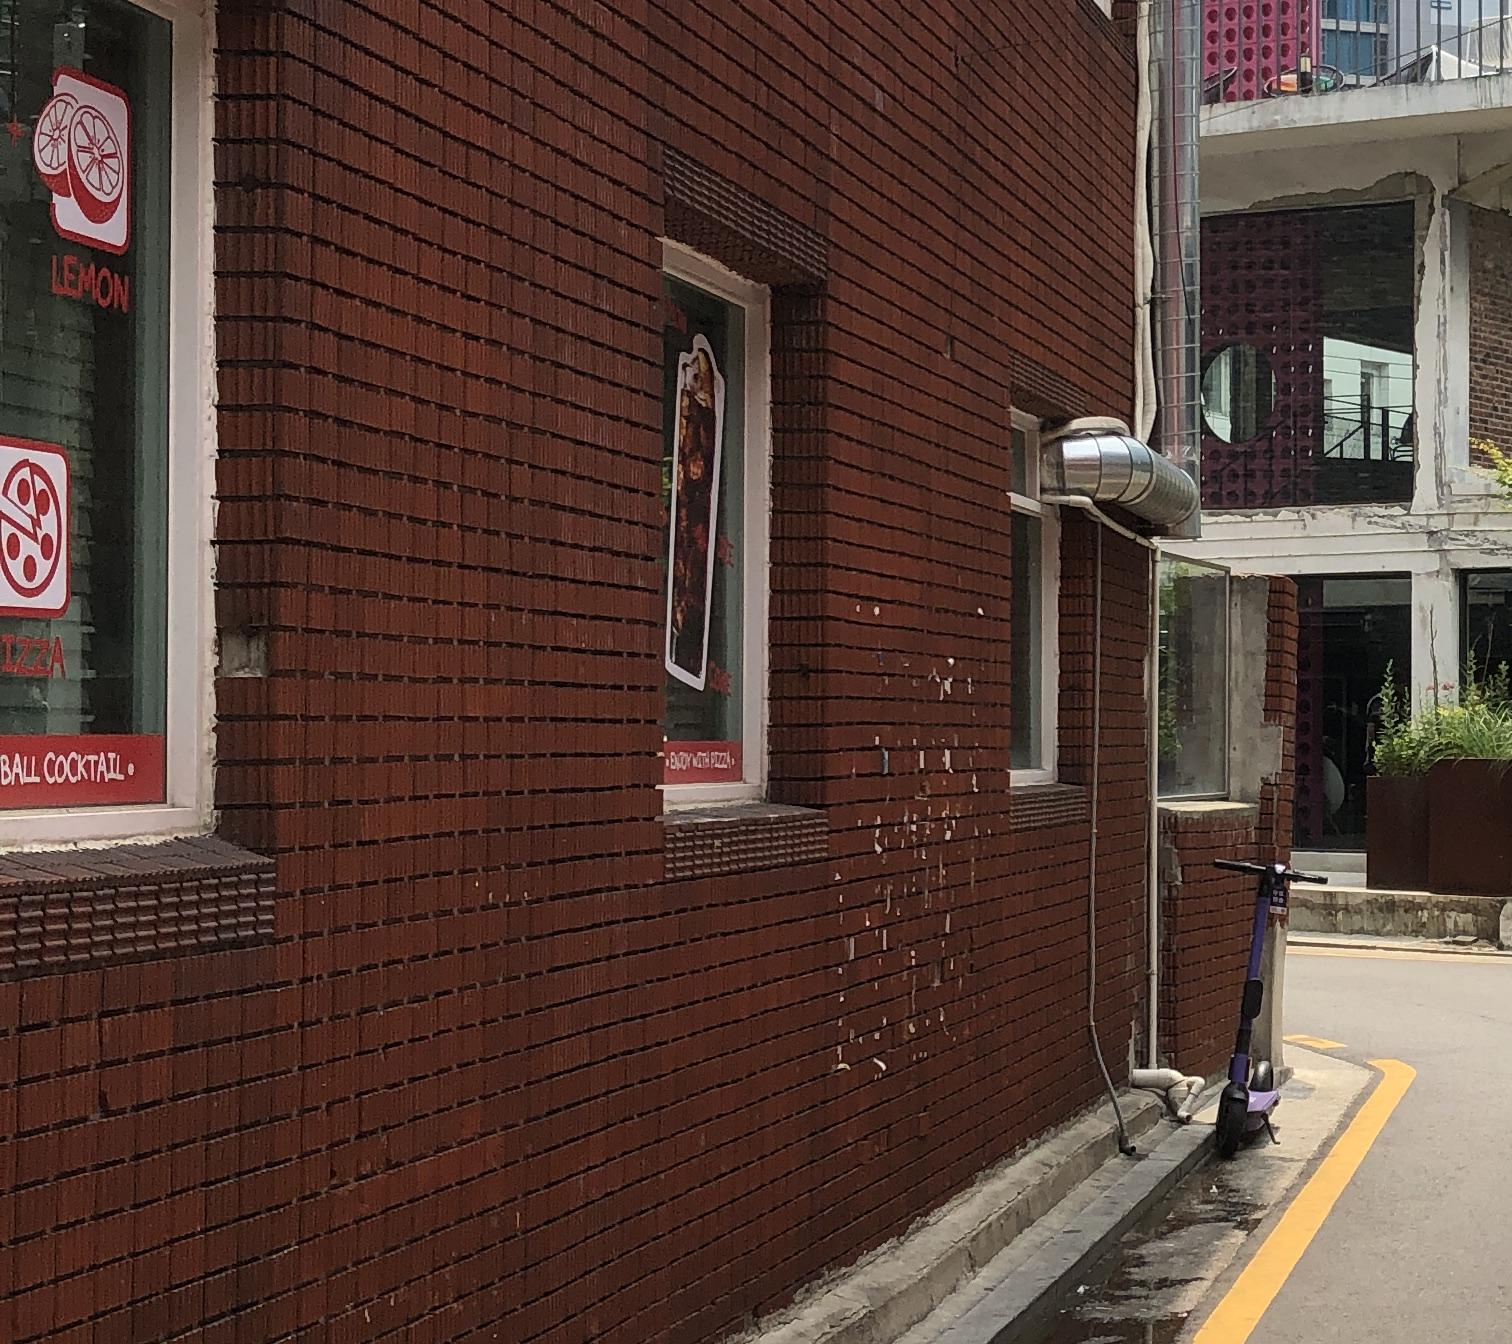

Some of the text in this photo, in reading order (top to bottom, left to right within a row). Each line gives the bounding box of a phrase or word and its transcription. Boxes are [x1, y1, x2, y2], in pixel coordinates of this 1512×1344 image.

[51, 255, 129, 314] LEMON
[0, 751, 125, 786] BALL COCKTAIL
[670, 750, 731, 771] ENJOY WITH PIZZA
